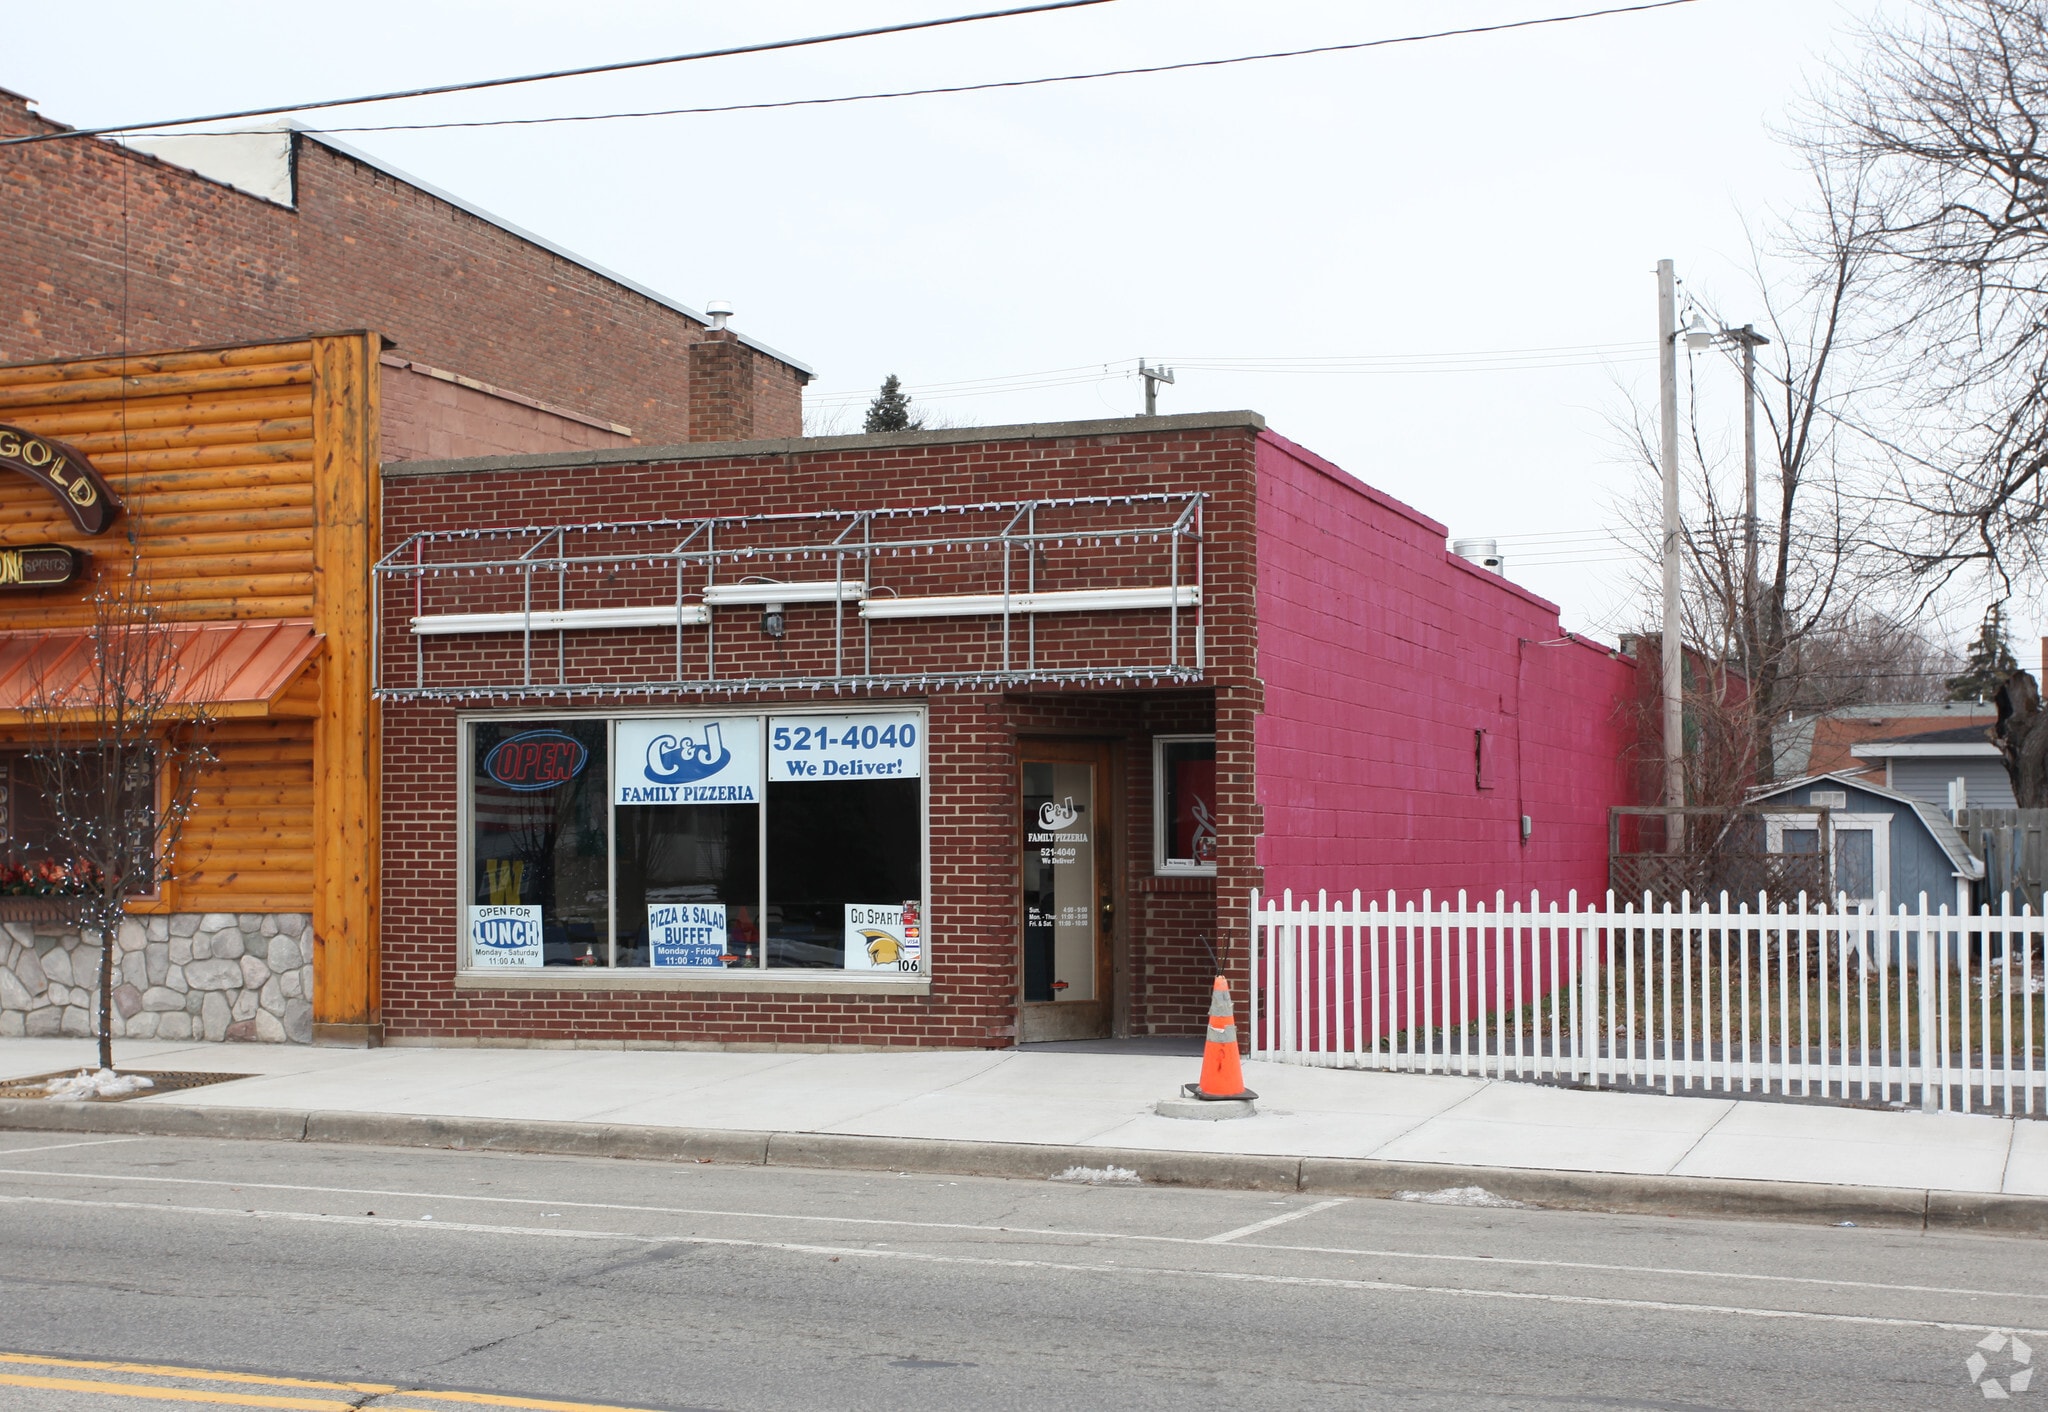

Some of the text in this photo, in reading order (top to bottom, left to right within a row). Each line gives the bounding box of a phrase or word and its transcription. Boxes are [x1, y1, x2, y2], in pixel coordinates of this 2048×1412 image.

[773, 723, 916, 751] 521-4040
[646, 722, 723, 776] C&J
[497, 743, 576, 780] OPEN
[786, 758, 903, 776] We Deliver!
[622, 785, 754, 802] FAMILY PIZZERIA
[1028, 833, 1088, 842] FAMILY PIZZERIA
[1040, 848, 1076, 856] 521-4040
[479, 906, 530, 917] OPEN FOR
[650, 906, 724, 930] PIZZA & SALAD
[474, 919, 539, 946] LUNCH
[665, 927, 713, 945] BUFFET
[475, 949, 502, 957] Monday
[508, 949, 539, 957] Saturday
[658, 947, 689, 957] Monday
[695, 947, 720, 957] Friday
[666, 957, 688, 965] 11:00
[695, 957, 713, 965] 7:00
[898, 960, 918, 971] 106
